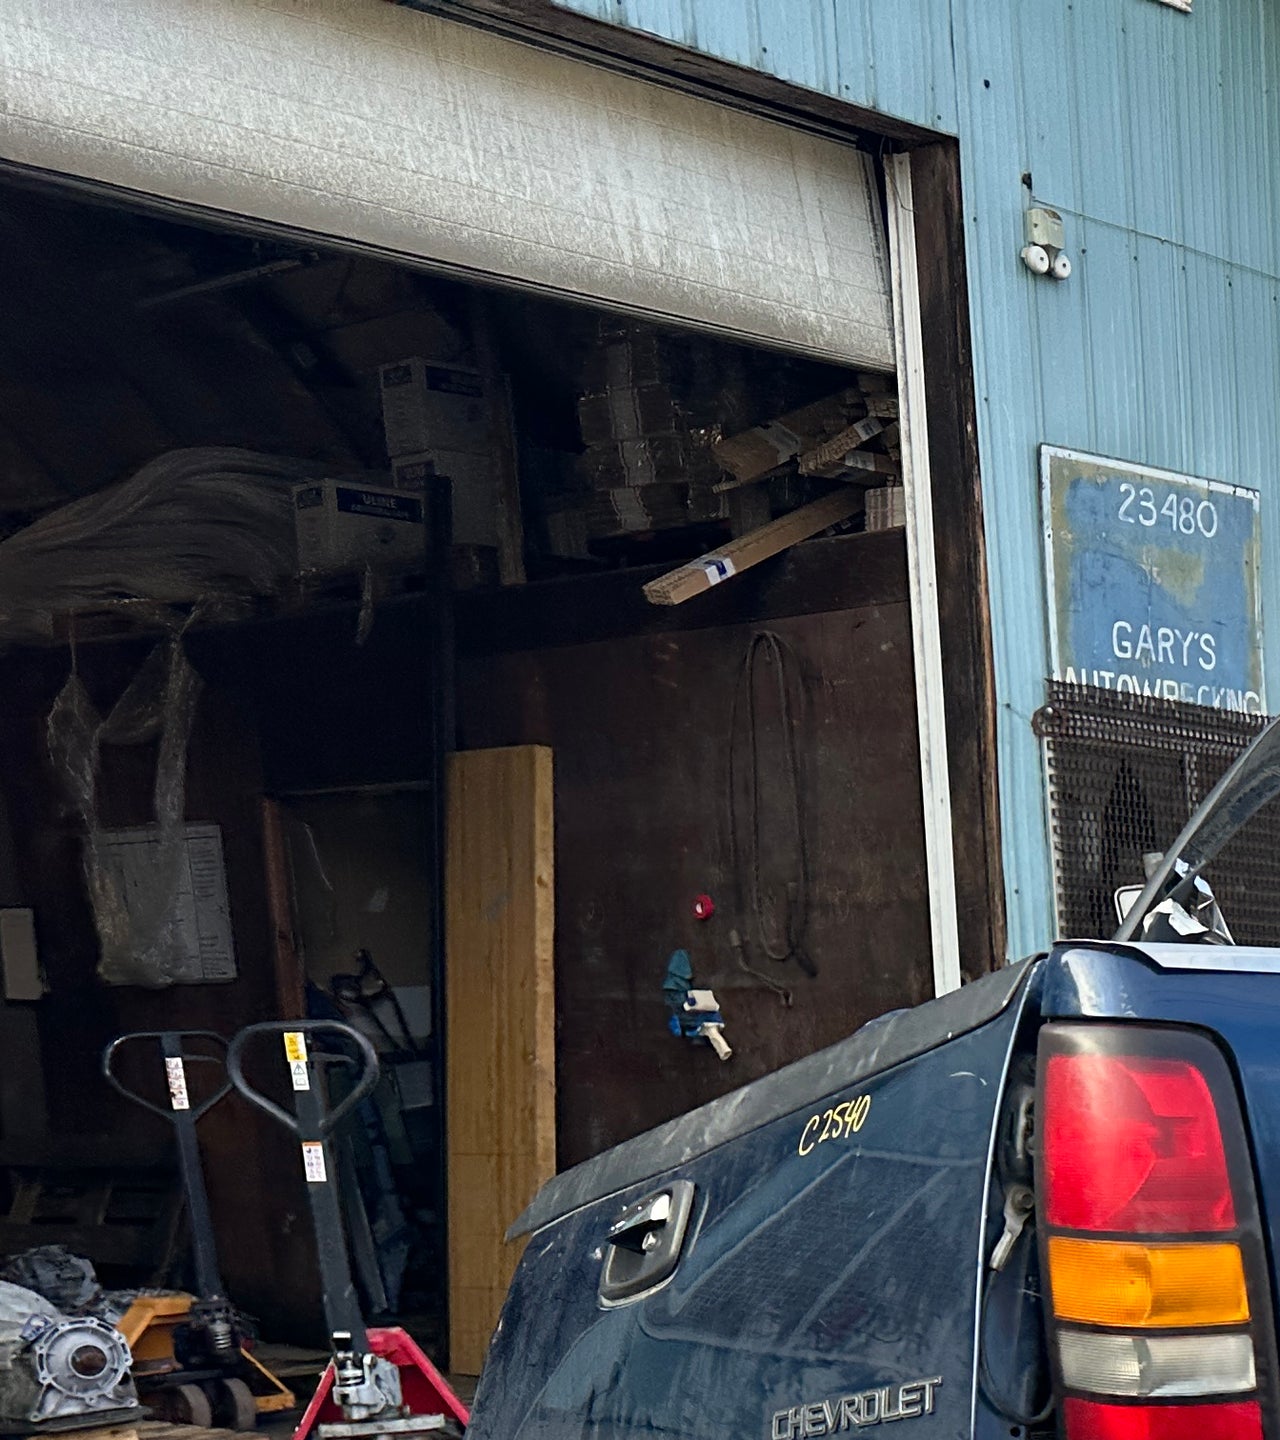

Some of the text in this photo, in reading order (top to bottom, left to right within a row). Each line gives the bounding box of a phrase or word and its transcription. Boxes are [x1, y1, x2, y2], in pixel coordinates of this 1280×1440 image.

[1117, 482, 1218, 538] 23480
[1112, 620, 1217, 671] GARY'S
[798, 1094, 871, 1156] C2540
